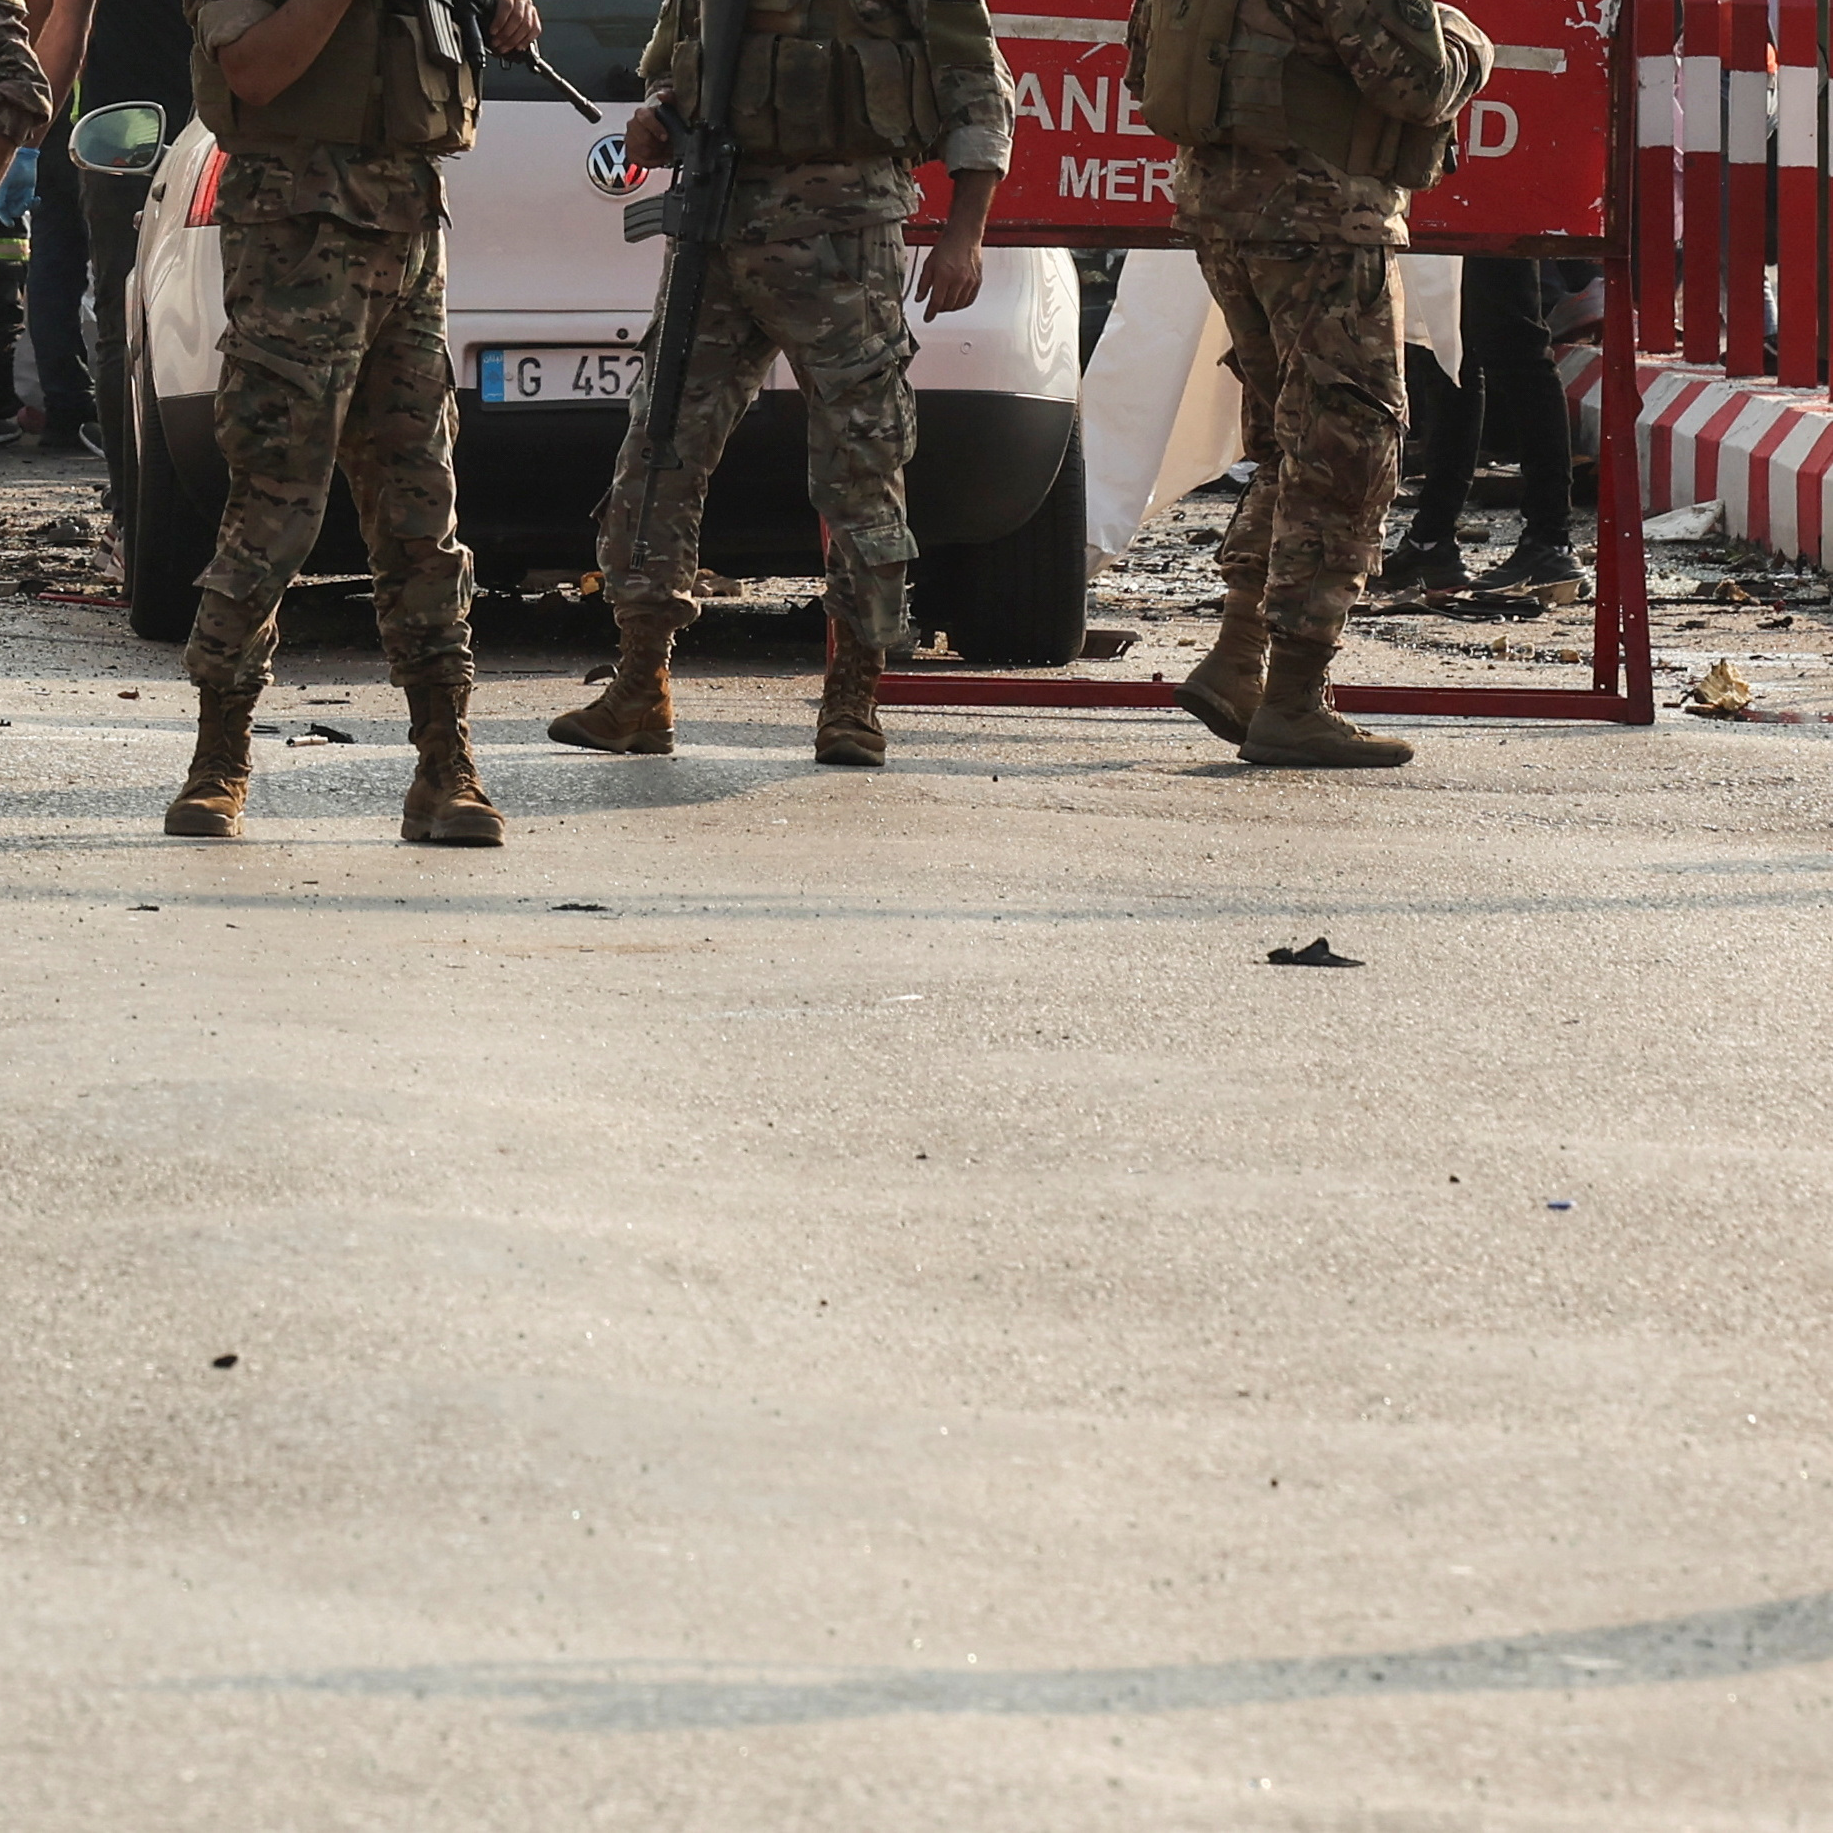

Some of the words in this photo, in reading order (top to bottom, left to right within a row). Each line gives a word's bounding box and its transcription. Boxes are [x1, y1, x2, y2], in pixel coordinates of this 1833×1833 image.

[1014, 72, 1156, 136] ANE
[1059, 155, 1179, 204] MER
[517, 356, 542, 397] G
[572, 355, 645, 396] 452
